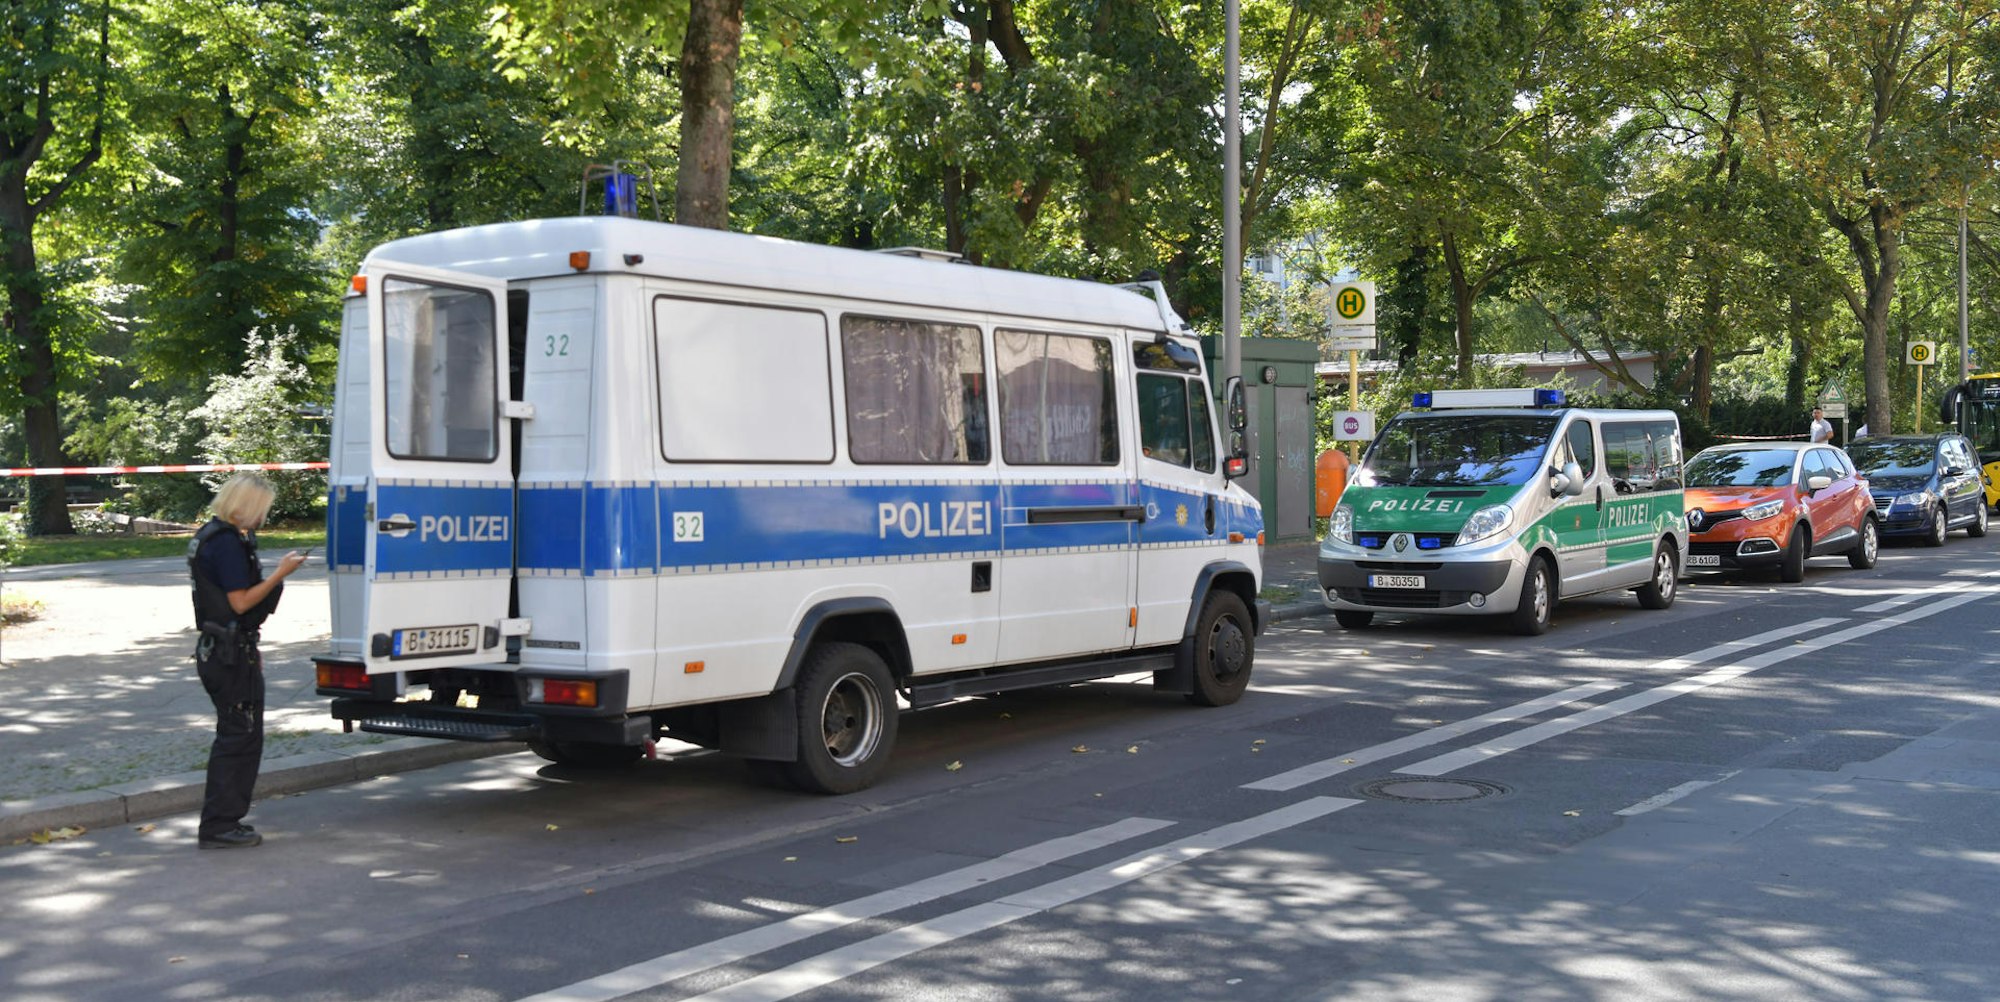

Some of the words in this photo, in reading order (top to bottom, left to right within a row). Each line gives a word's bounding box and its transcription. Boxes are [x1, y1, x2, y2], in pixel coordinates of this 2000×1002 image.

[544, 334, 569, 357] 32
[1344, 421, 1358, 430] BUS
[1367, 499, 1464, 513] POLIZEI
[1608, 503, 1649, 528] POLIZEI
[421, 515, 509, 542] POLIZEI
[676, 516, 701, 538] 32
[878, 501, 992, 539] POLIZEI
[427, 629, 470, 650] 31115
